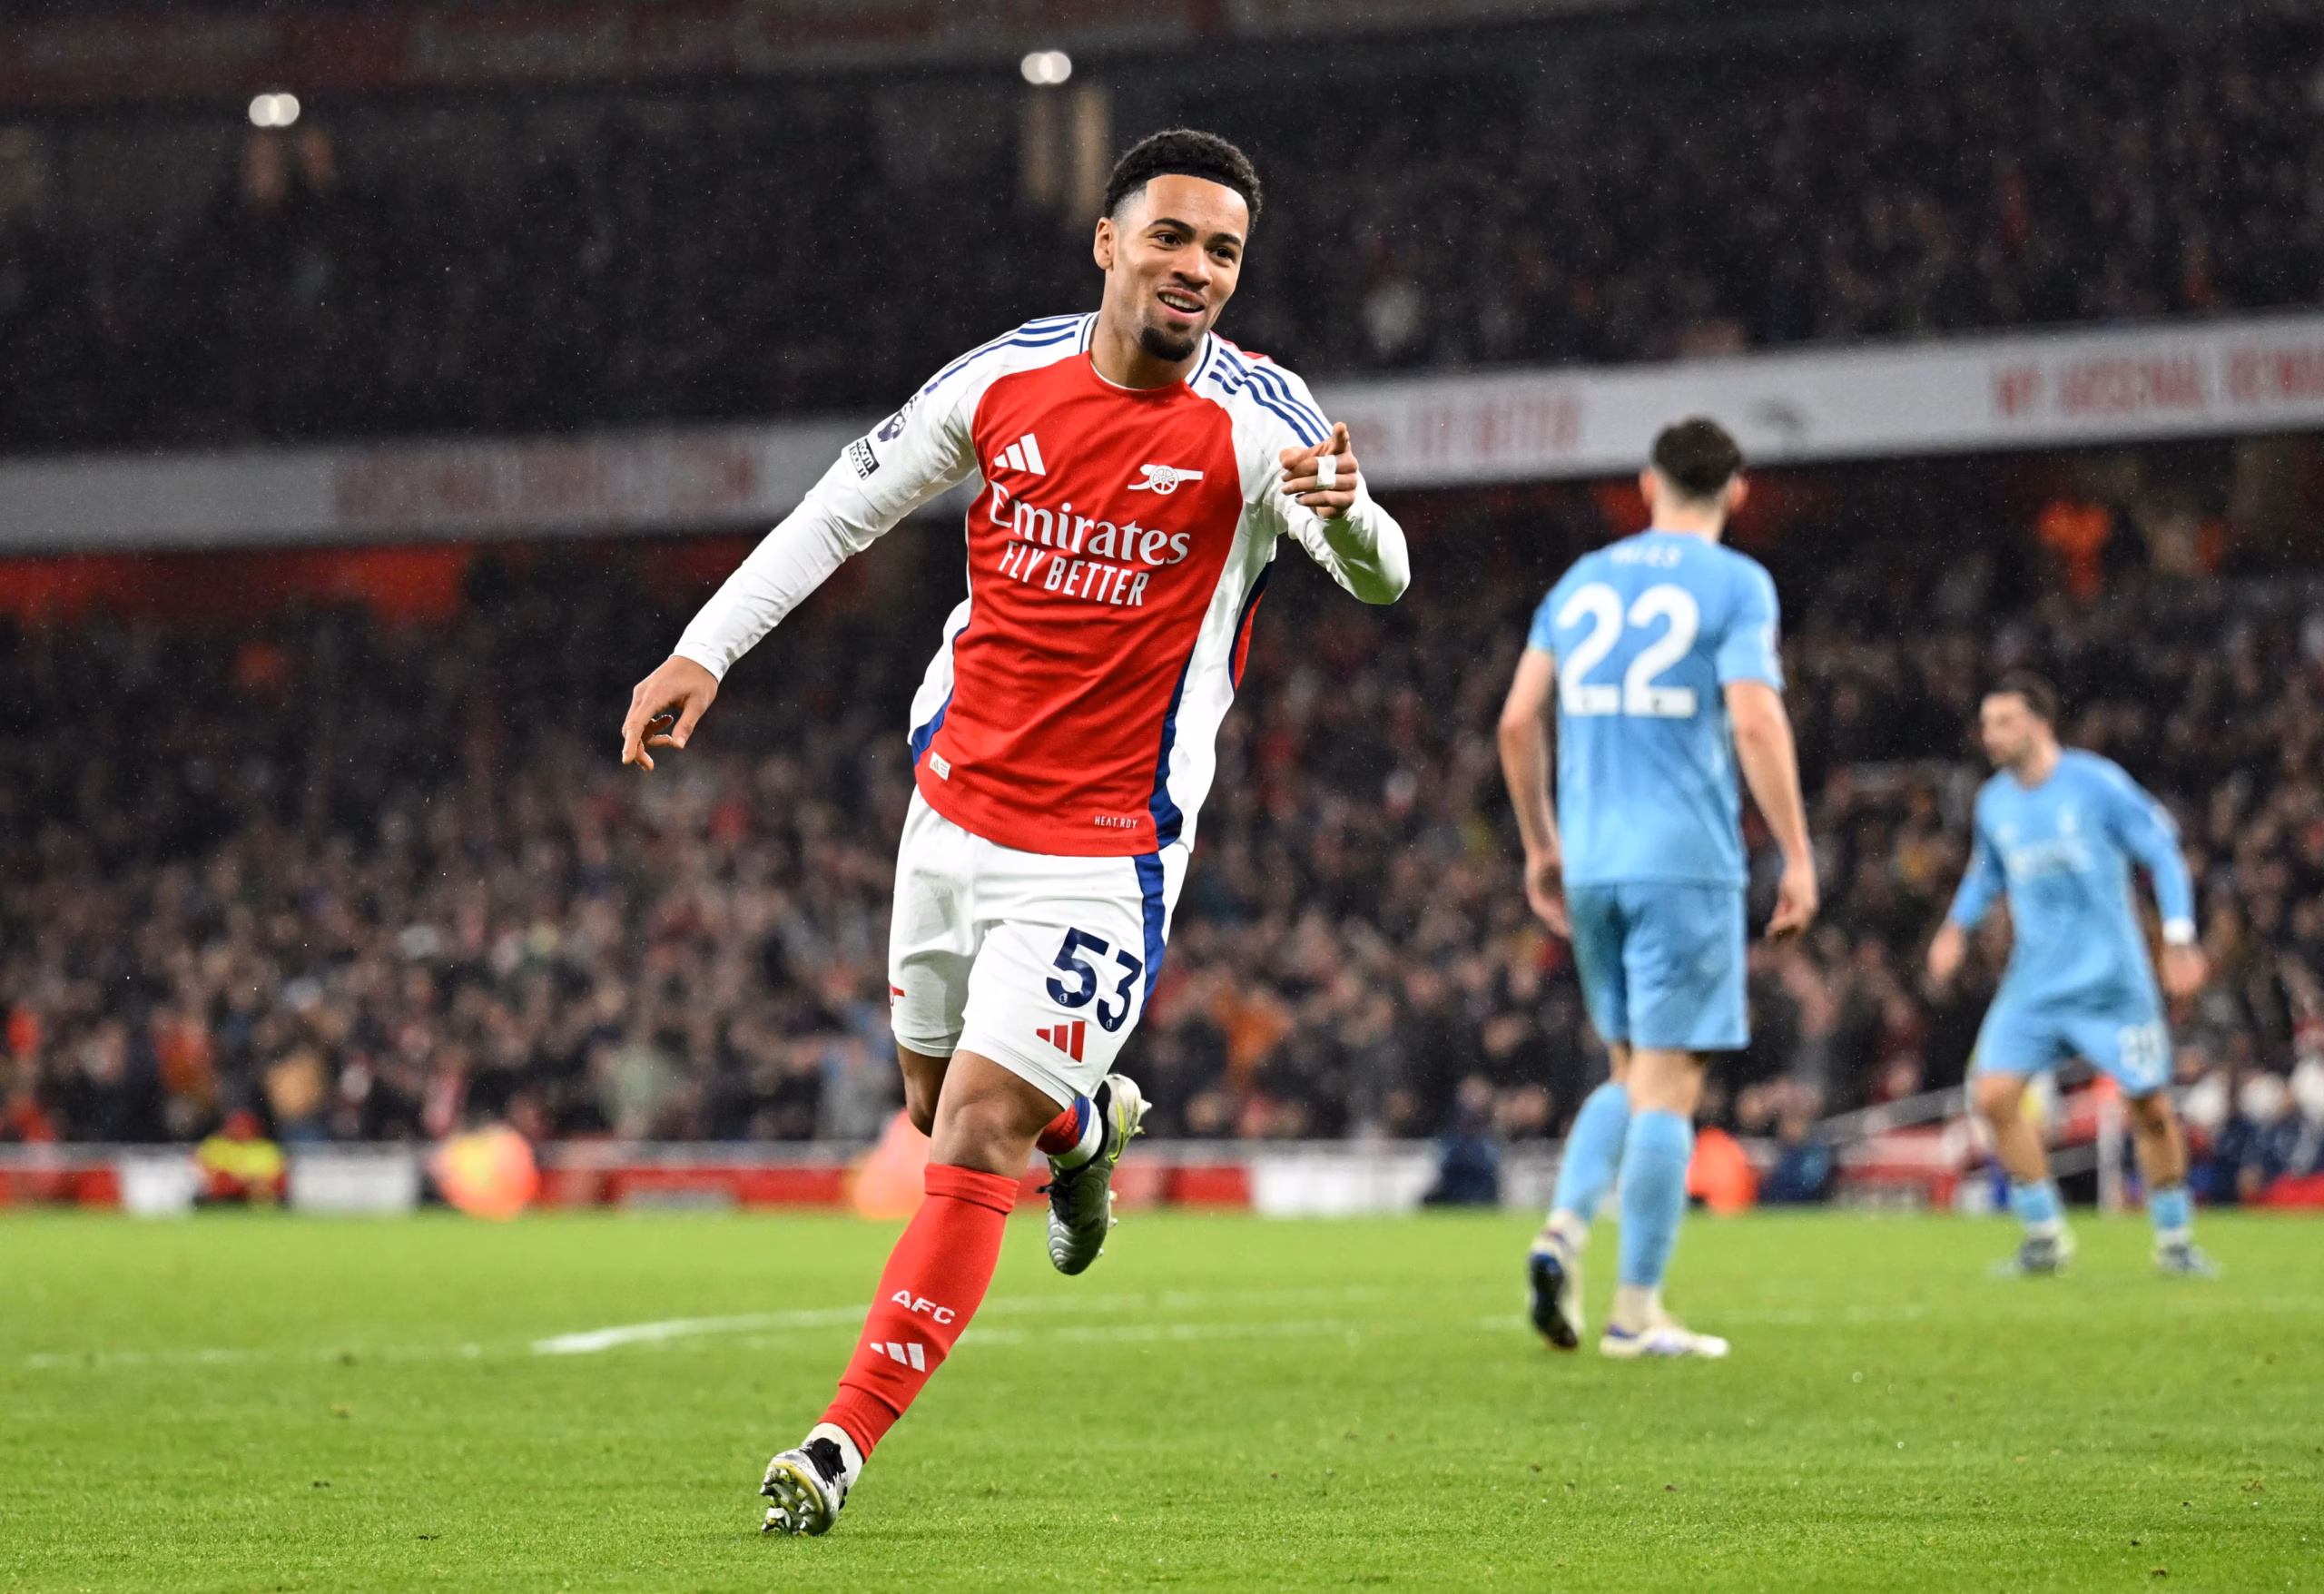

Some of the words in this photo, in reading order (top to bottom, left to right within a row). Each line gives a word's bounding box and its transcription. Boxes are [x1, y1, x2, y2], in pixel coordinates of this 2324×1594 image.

[990, 479, 1191, 566] Emirates
[999, 540, 1046, 584] FLY
[1044, 556, 1150, 606] BETTER
[1554, 581, 1700, 715] 22
[1094, 815, 1137, 829] HEAT.RDY
[1046, 927, 1144, 1033] 53
[891, 1290, 956, 1324] AFC
